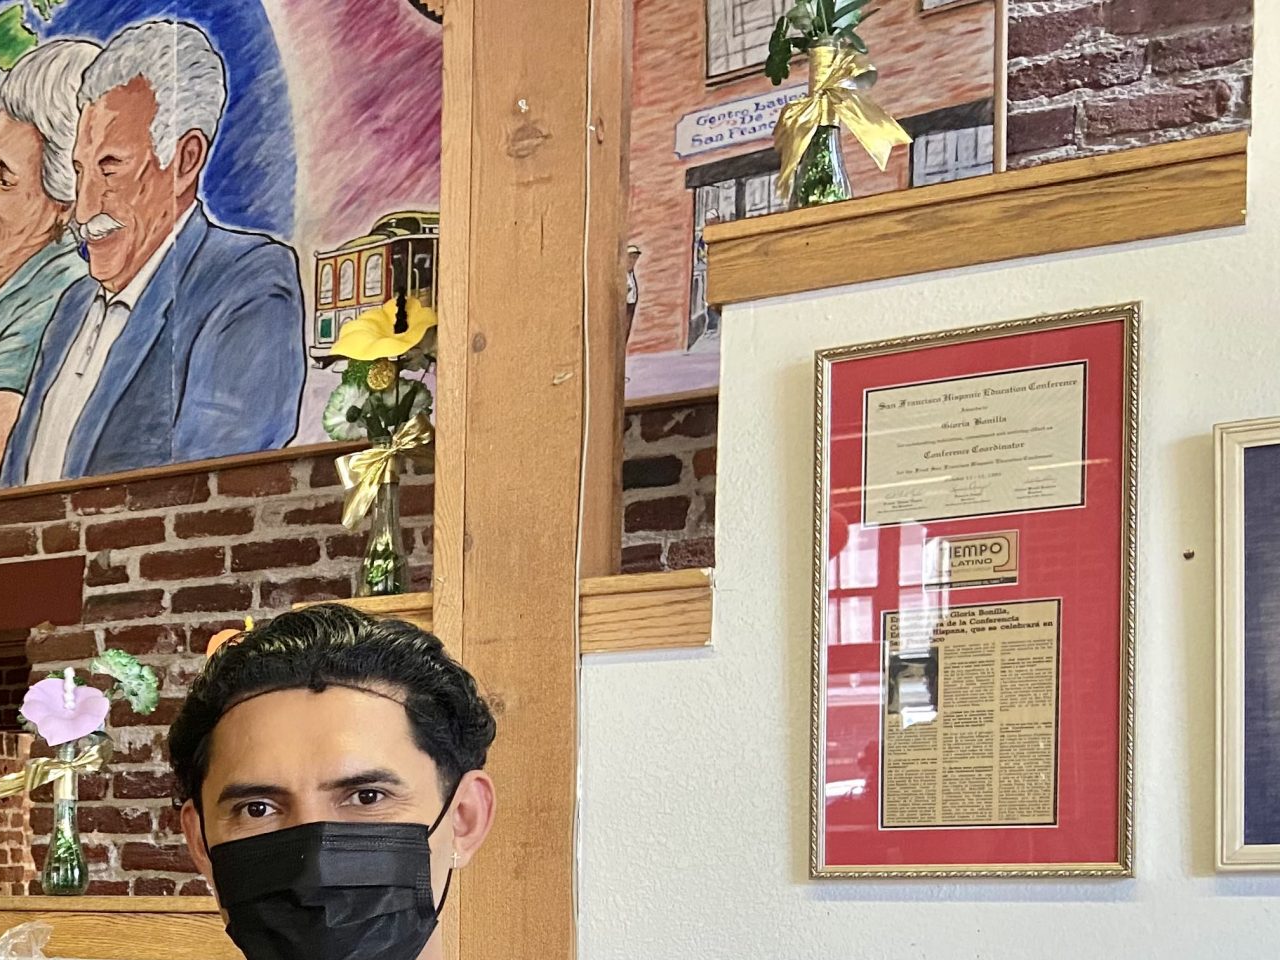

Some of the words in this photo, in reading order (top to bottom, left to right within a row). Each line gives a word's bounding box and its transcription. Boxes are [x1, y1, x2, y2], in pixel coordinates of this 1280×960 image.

[692, 133, 724, 147] San
[898, 397, 941, 408] Francisco
[942, 391, 981, 403] Hispanic
[984, 384, 1026, 397] Education
[1028, 379, 1077, 391] Conference
[924, 448, 969, 460] Conference
[971, 441, 1025, 453] Coordinator
[951, 558, 992, 568] LATINO
[950, 609, 975, 619] Gloria
[978, 607, 1009, 618] Bonilla,
[946, 620, 957, 628] de
[959, 619, 967, 627] la
[969, 615, 1019, 626] Conferencia
